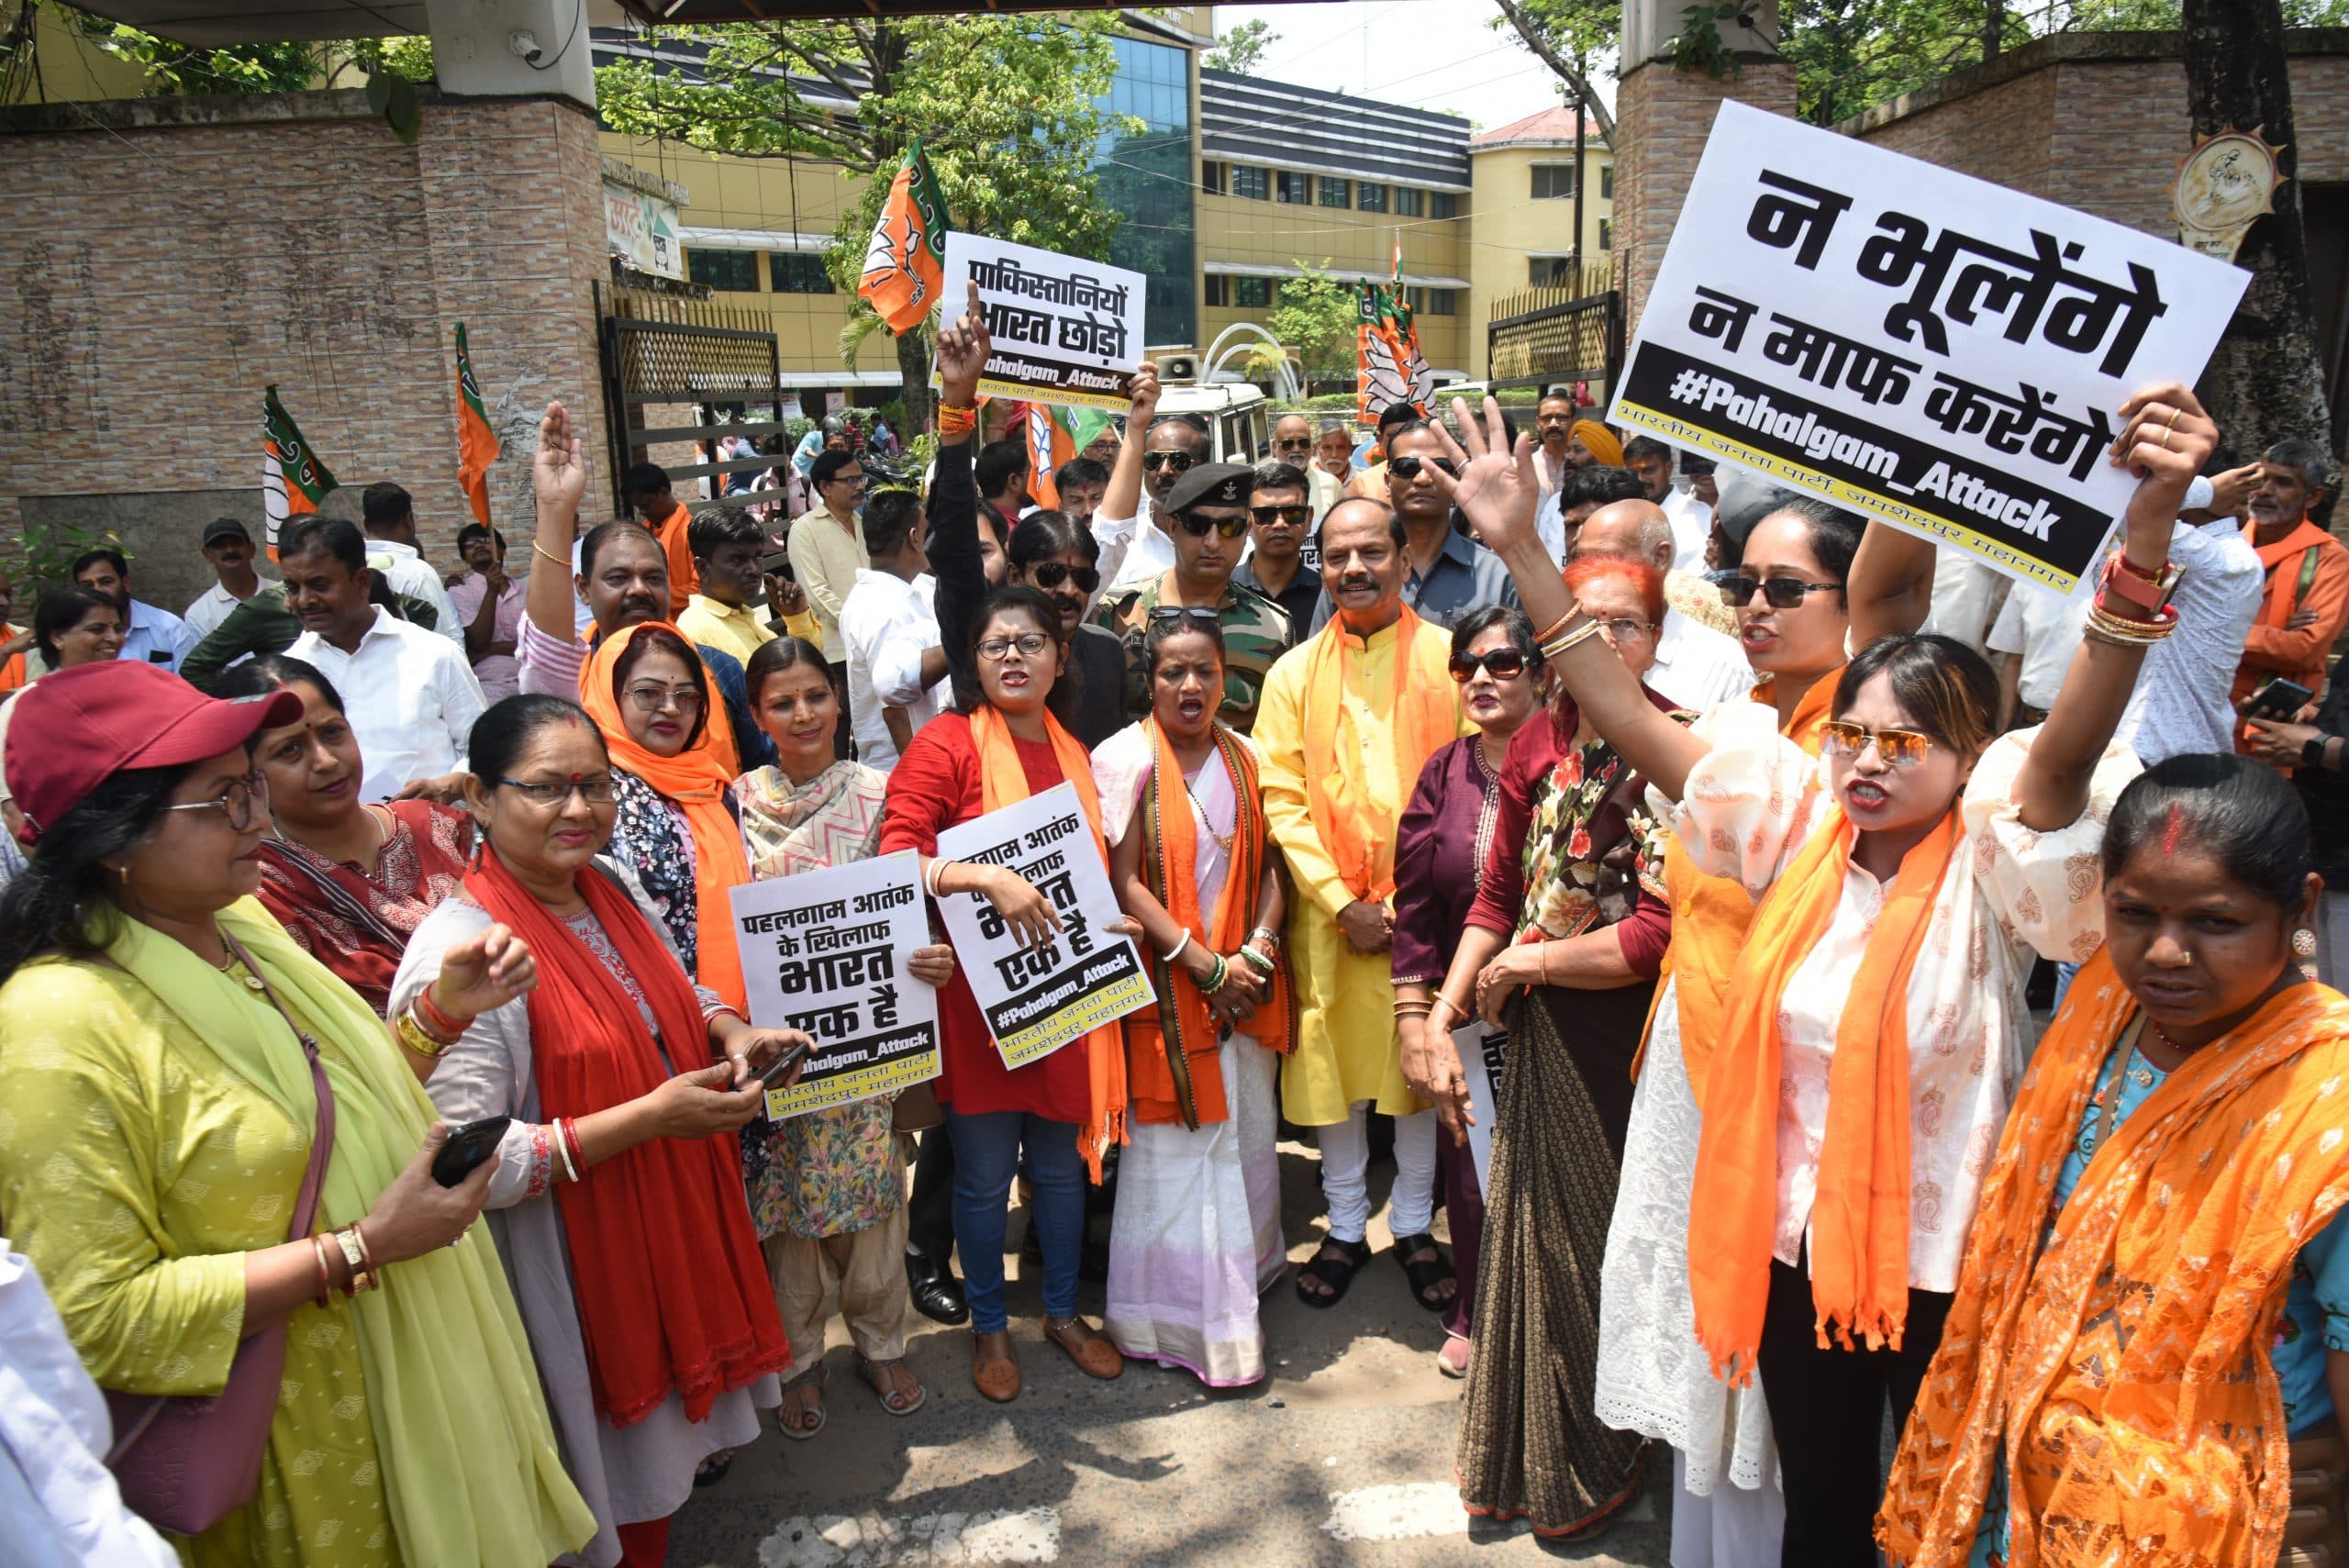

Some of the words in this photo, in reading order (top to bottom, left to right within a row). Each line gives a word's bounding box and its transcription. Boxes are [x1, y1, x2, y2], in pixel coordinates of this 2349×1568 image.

[968, 258, 1130, 317] पाकिस्तानियों
[1747, 169, 1854, 272] न
[1856, 210, 2168, 379] भूलेंगे
[985, 355, 1121, 391] ahalgam_Attack
[1688, 285, 1760, 352] न
[1763, 312, 1922, 406] माफ
[1924, 371, 2117, 483] करेंगे
[1670, 368, 2062, 543] #Pahalgam_Attack
[1621, 404, 1704, 443] भारतीय
[1711, 438, 1776, 470] जनता
[1845, 489, 1966, 538] जमशेदपुर
[1972, 538, 2074, 587] महानगर
[1024, 813, 1080, 850] आतंक
[741, 899, 846, 934] पहलगाम
[852, 883, 915, 914] आतंक
[1060, 908, 1095, 957] है
[776, 934, 799, 957] के
[804, 919, 891, 953] खिलाफ
[779, 943, 895, 994] भारत
[997, 953, 1130, 1029] #Pahalgam_Attack
[867, 983, 898, 1029] है
[1061, 994, 1102, 1020] जनता
[770, 1079, 836, 1101] भारतीय
[842, 1065, 890, 1084] जनता
[867, 1065, 934, 1090] महानगर
